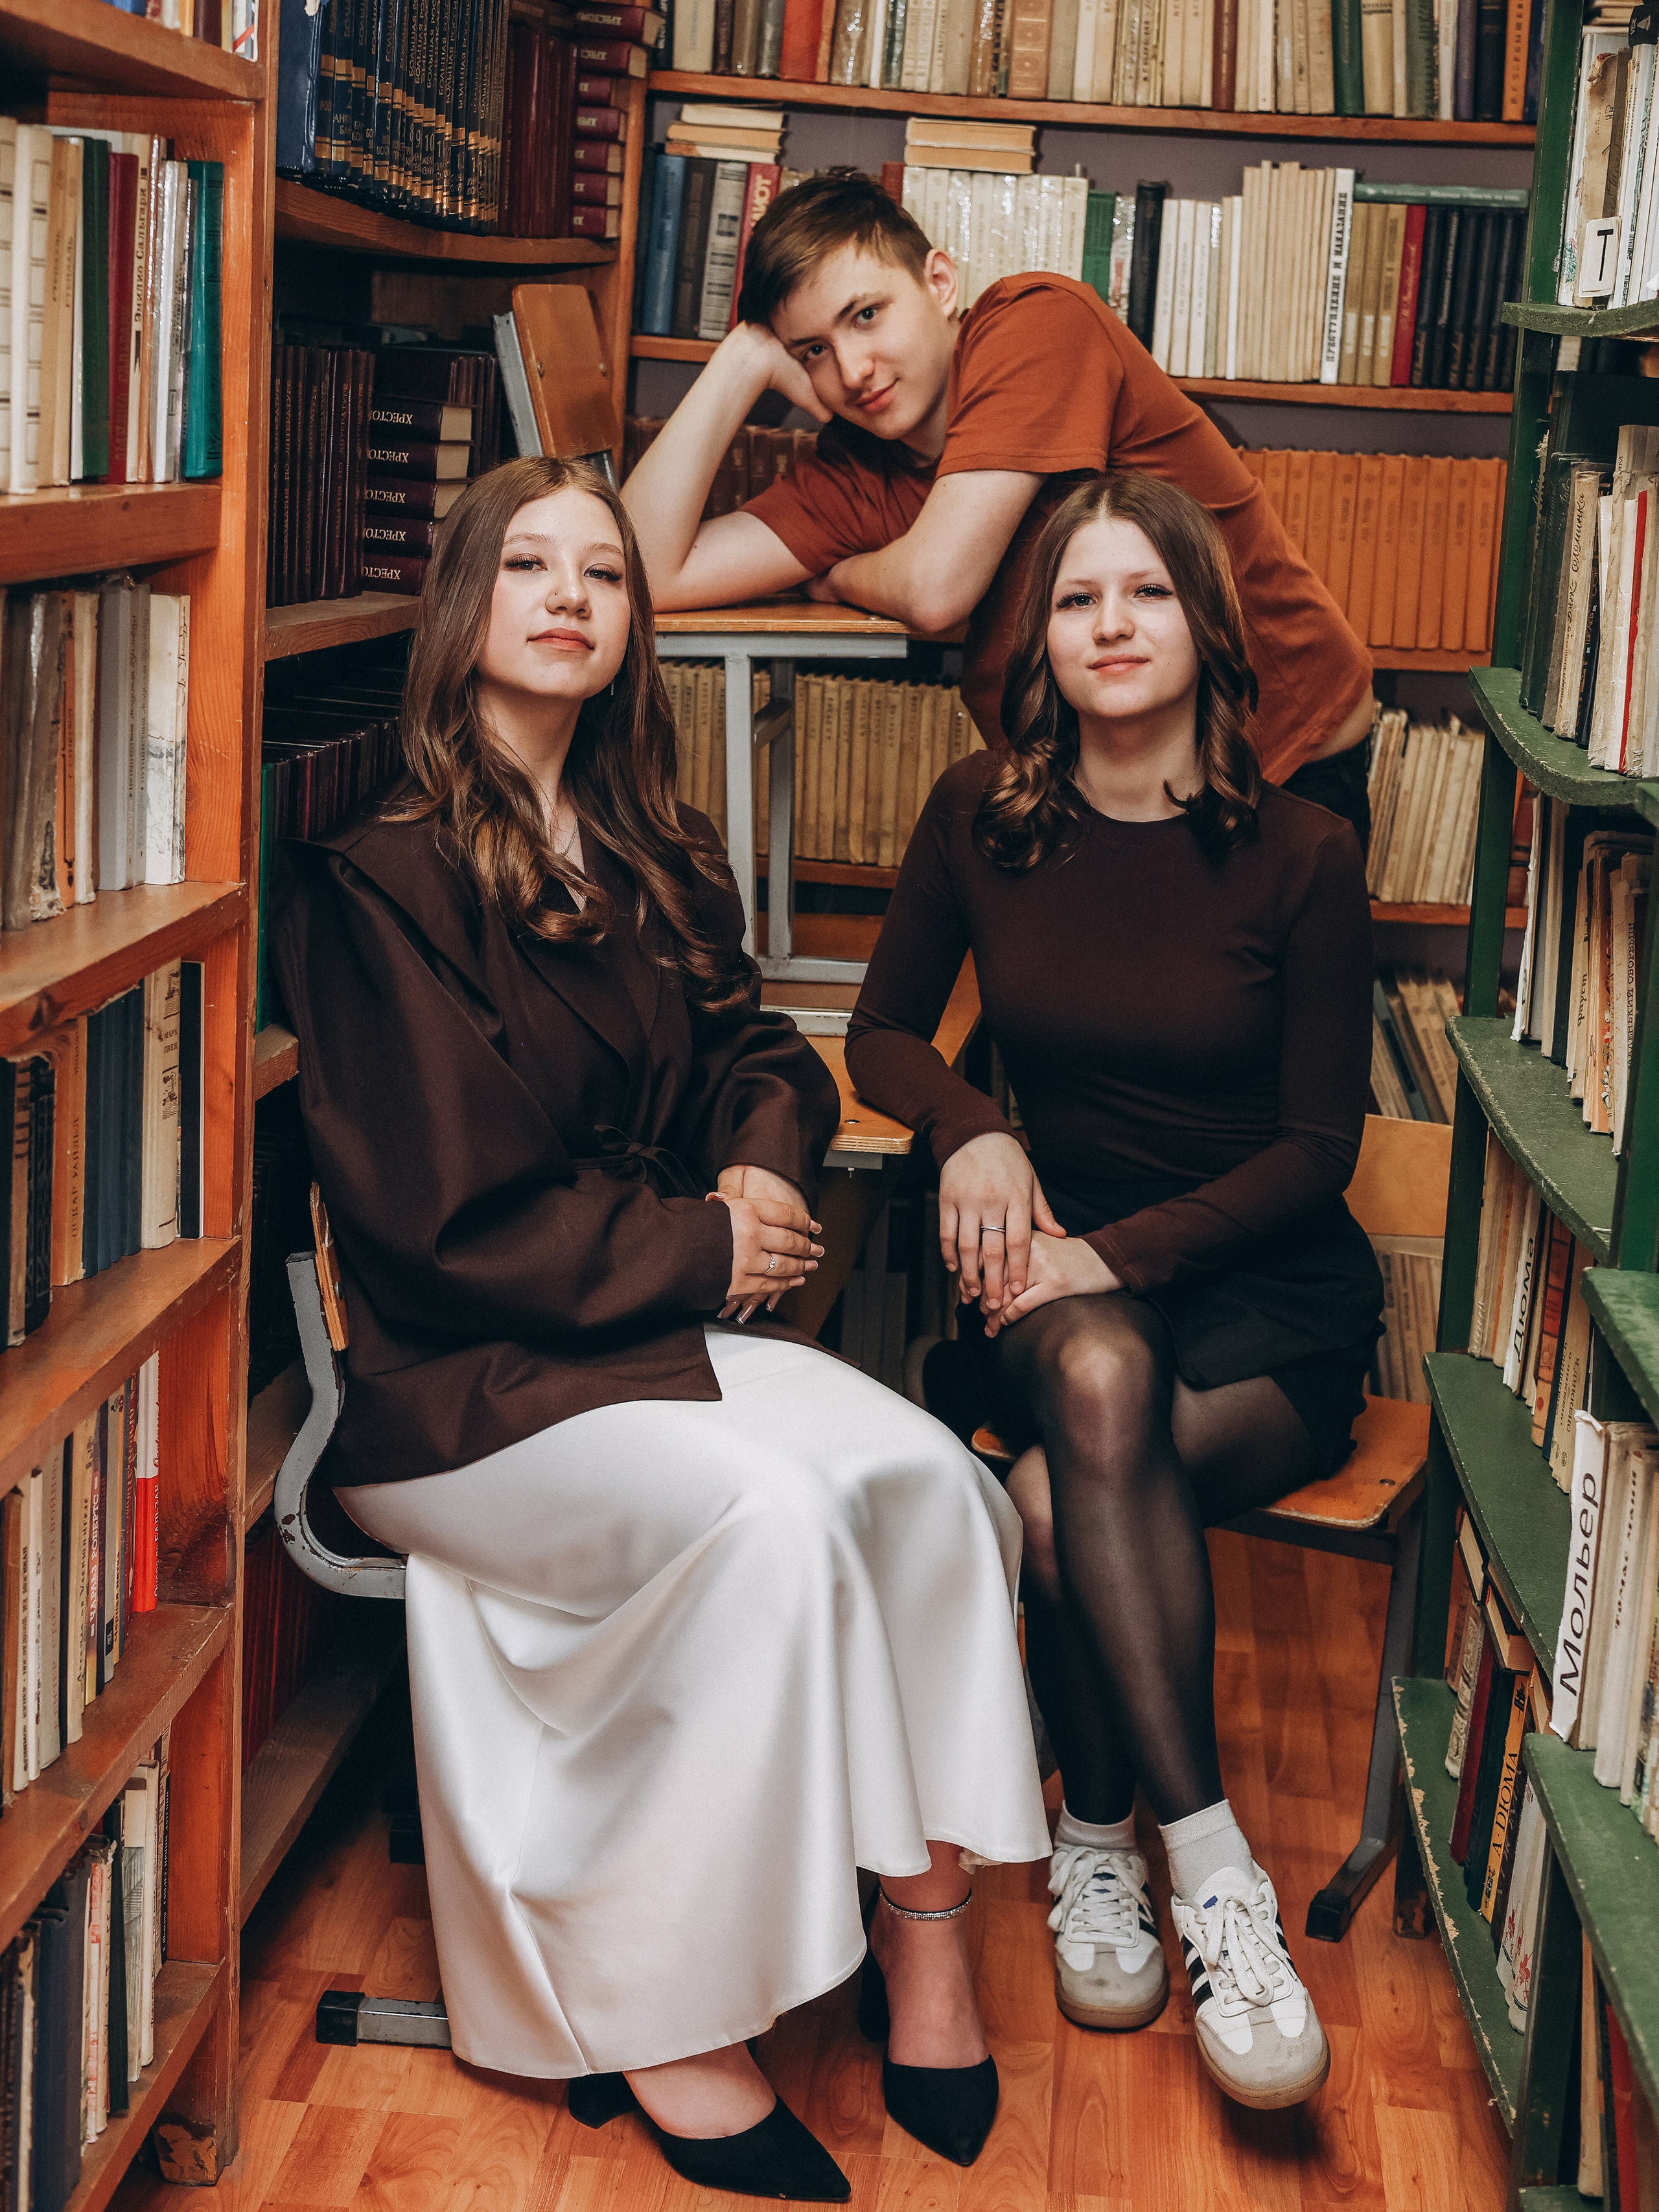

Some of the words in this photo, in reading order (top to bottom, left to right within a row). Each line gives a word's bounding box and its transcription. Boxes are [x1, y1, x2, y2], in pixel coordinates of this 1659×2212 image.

[135, 188, 148, 259] Сальгари
[134, 266, 145, 323] Эмилио
[1325, 275, 1341, 362] ПРЕСТУПЛЕНИЕ
[1334, 192, 1348, 256] НАКАЗАНИЕ
[372, 410, 413, 425] ХРЕСТО
[369, 449, 410, 463] ХРЕСТО
[366, 490, 406, 504] ХРЕСТО
[365, 528, 406, 542] ХРЕСТО
[1513, 1237, 1534, 1363] Дюма
[89, 1564, 98, 1622] ЧАРЛЬЗ
[1559, 1471, 1599, 1697] Мольер
[1494, 1752, 1518, 1832] ДЮМА
